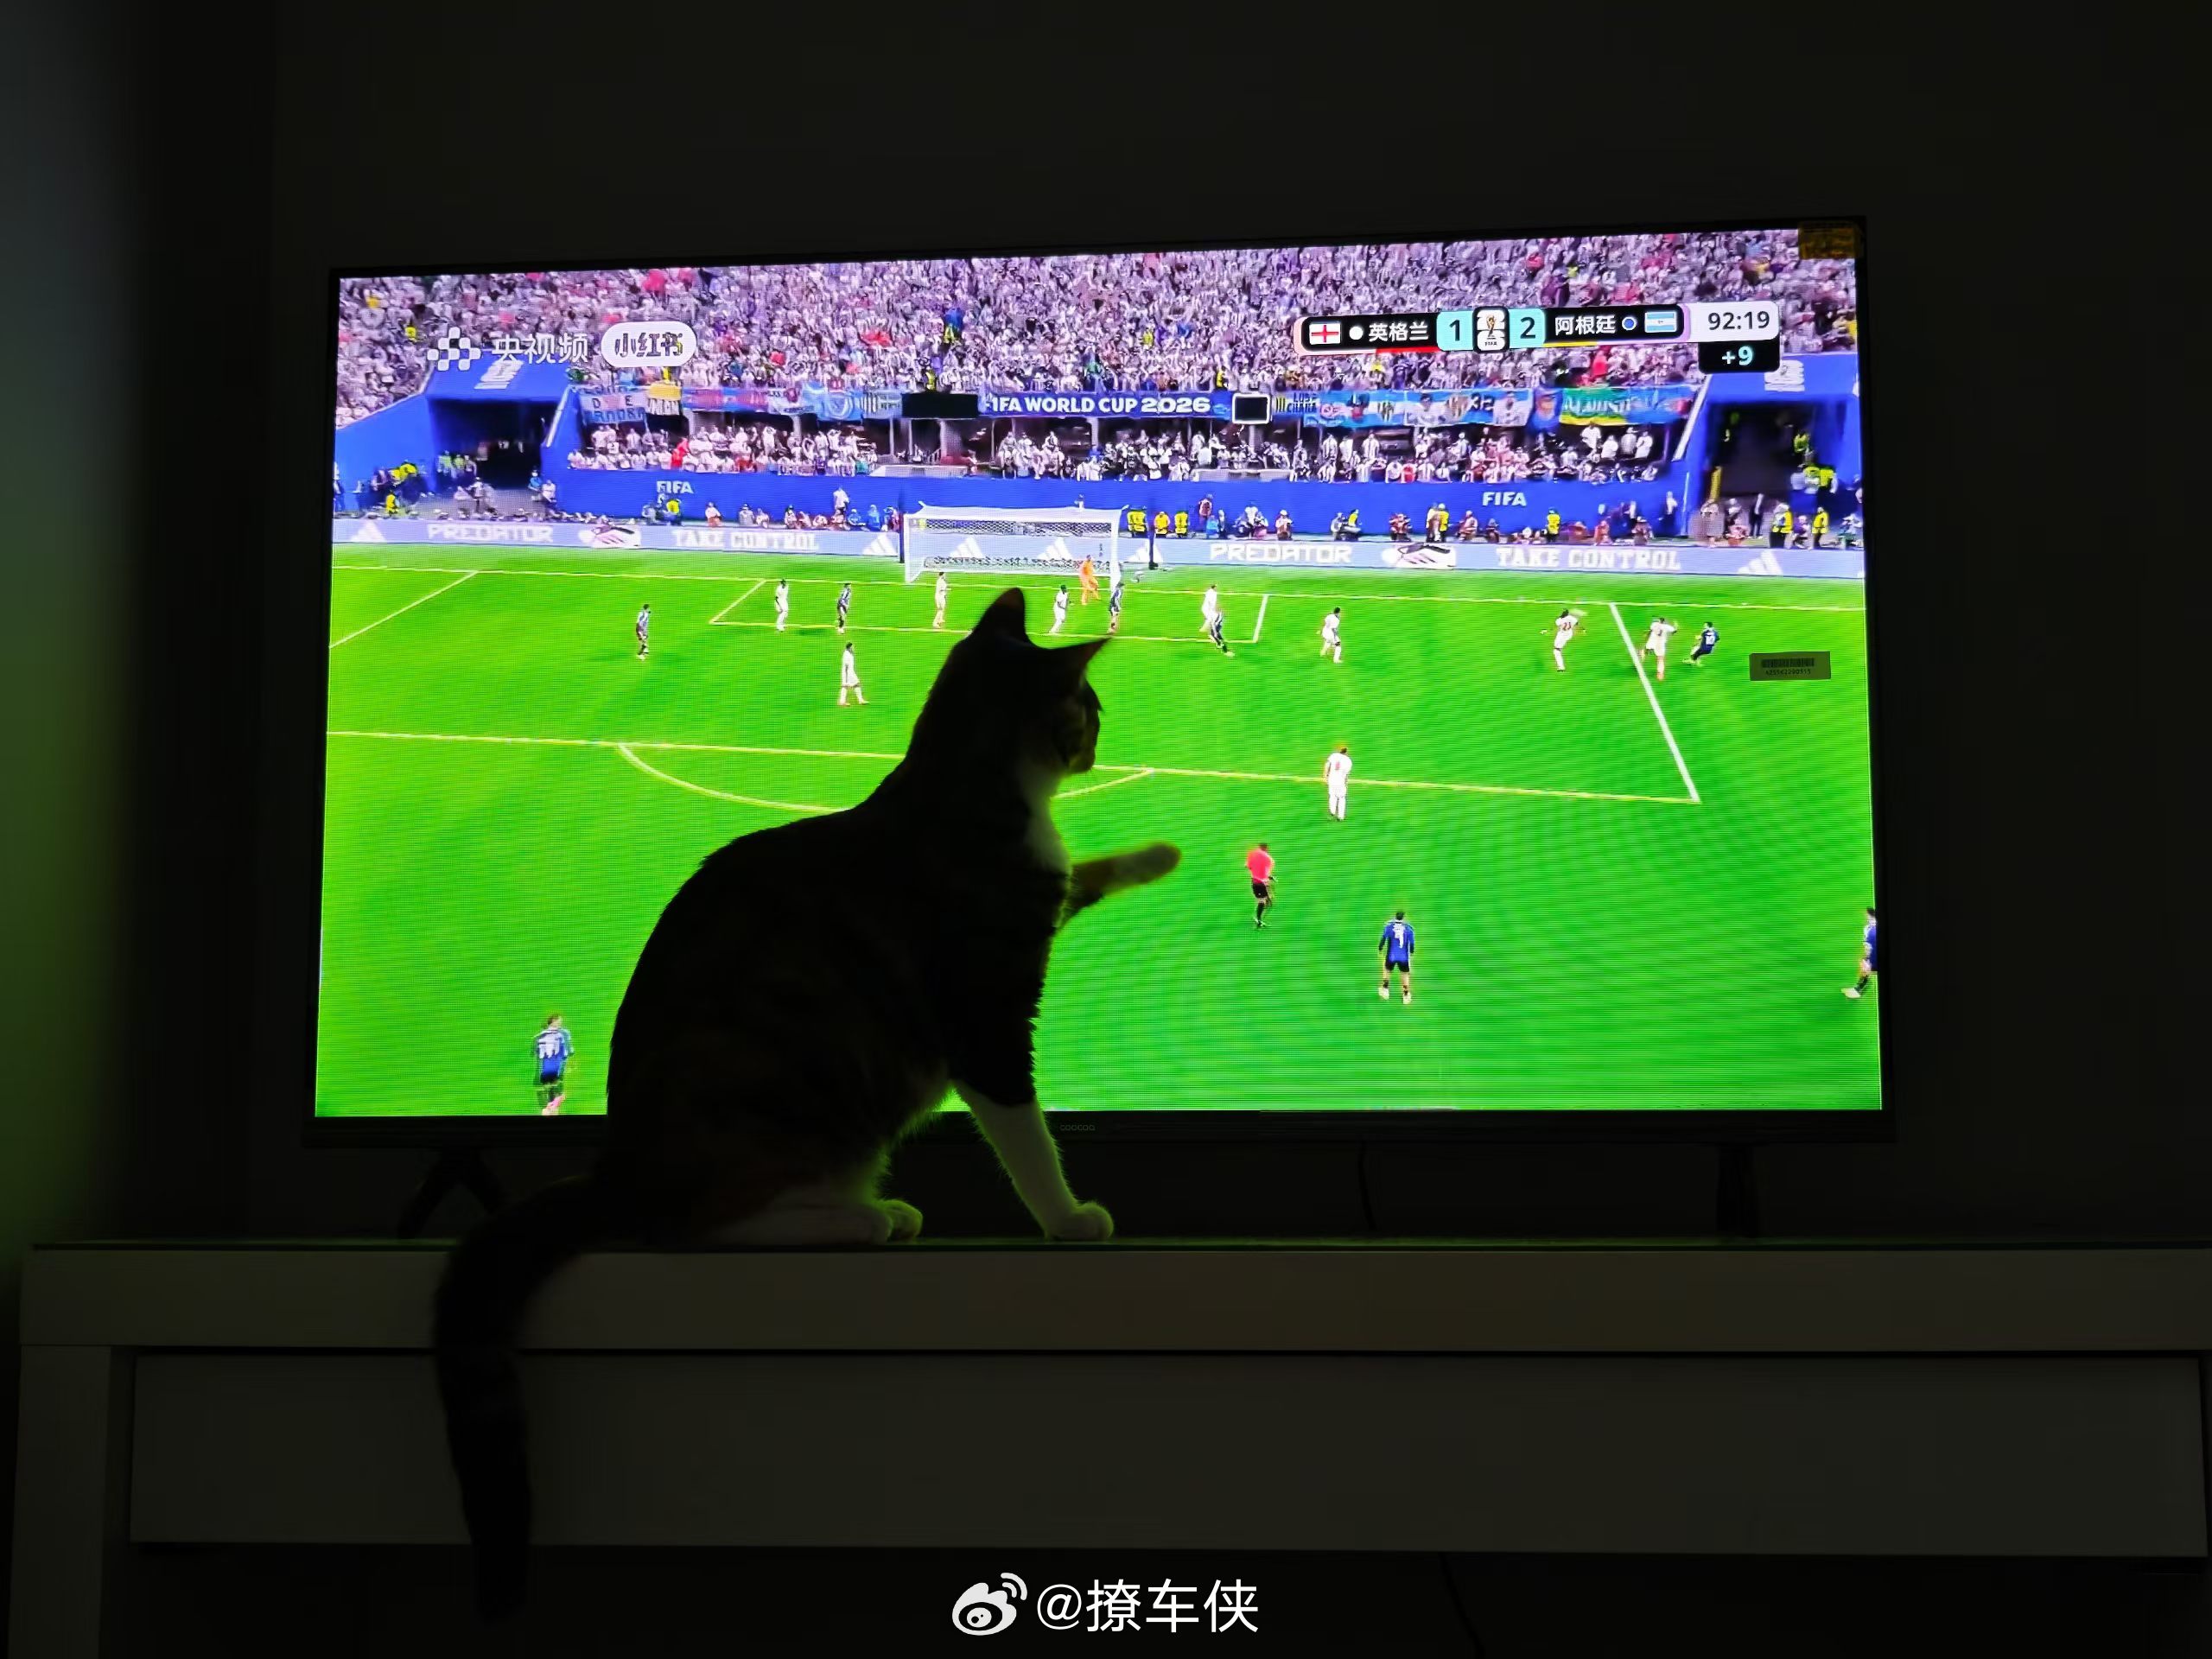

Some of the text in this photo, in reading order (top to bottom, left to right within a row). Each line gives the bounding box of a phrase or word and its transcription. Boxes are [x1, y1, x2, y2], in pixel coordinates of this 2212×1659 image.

[1448, 319, 1461, 342] 1
[1519, 316, 1536, 340] 2
[1554, 315, 1616, 336] 阿根廷
[1707, 310, 1770, 330] 92:19
[1368, 321, 1429, 342] 英格兰
[491, 332, 589, 365] 央视频
[613, 332, 684, 358] 小红书
[1721, 346, 1754, 365] +9
[1024, 397, 1096, 414] WORLD
[1098, 397, 1138, 414] CUP
[1141, 397, 1211, 414] 2026
[656, 480, 694, 495] FIFA
[1482, 491, 1528, 507] FIFA
[1210, 543, 1354, 563] PREDATOR
[1496, 547, 1681, 570] TAKE CONTROL
